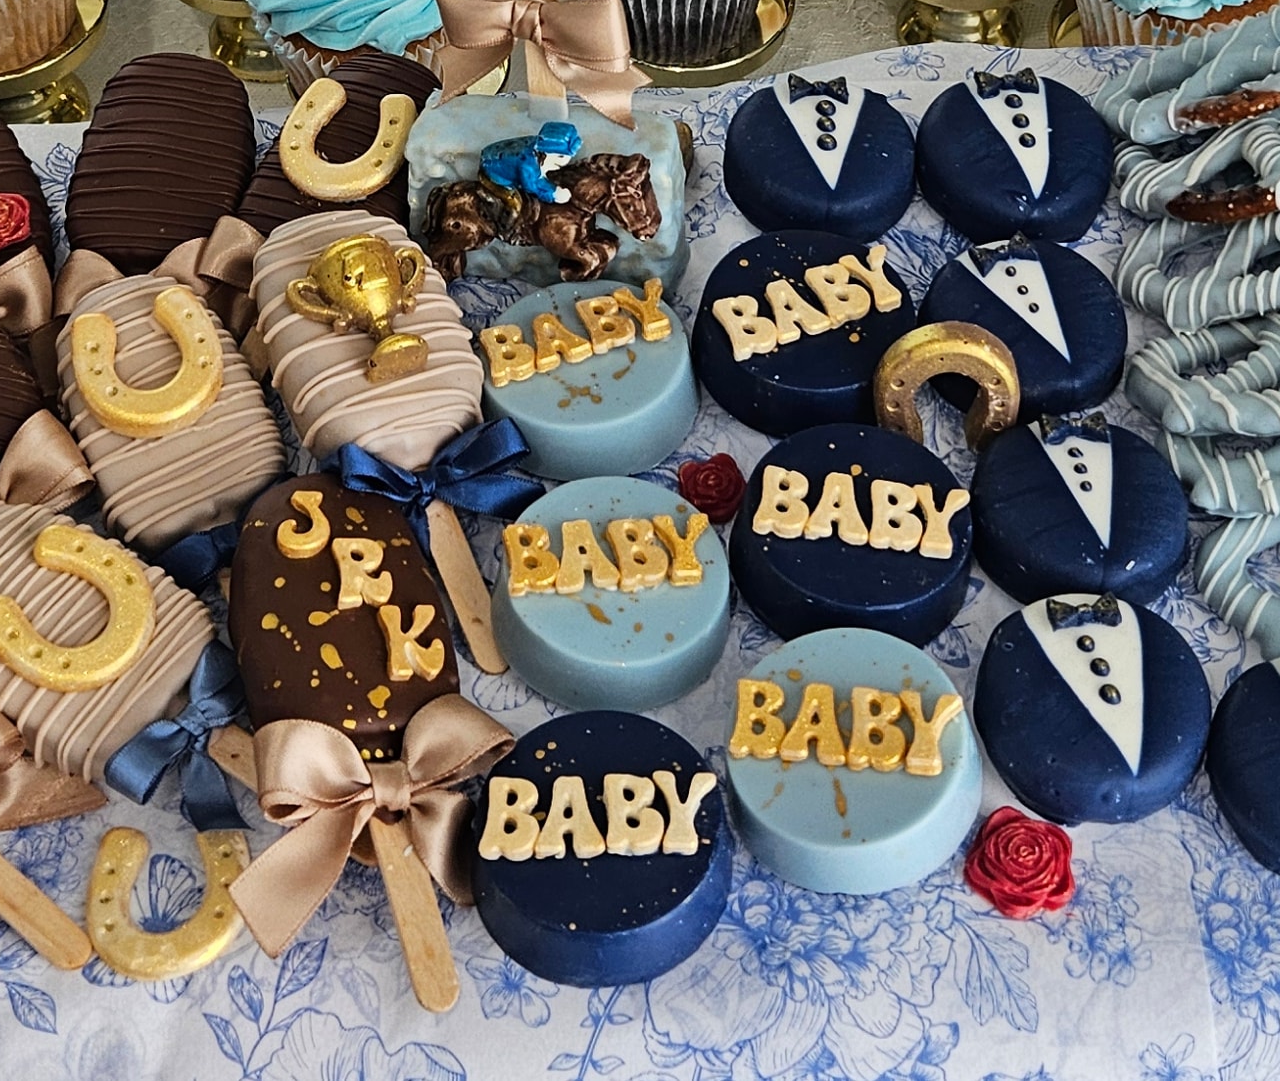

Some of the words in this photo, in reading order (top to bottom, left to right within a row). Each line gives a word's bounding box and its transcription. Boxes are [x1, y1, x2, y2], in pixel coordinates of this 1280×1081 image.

[480, 278, 671, 386] BABY
[713, 245, 903, 361] BABY
[503, 513, 708, 595] BABY
[752, 465, 970, 559] BABY
[729, 679, 962, 776] BABY
[478, 770, 717, 861] BABY
